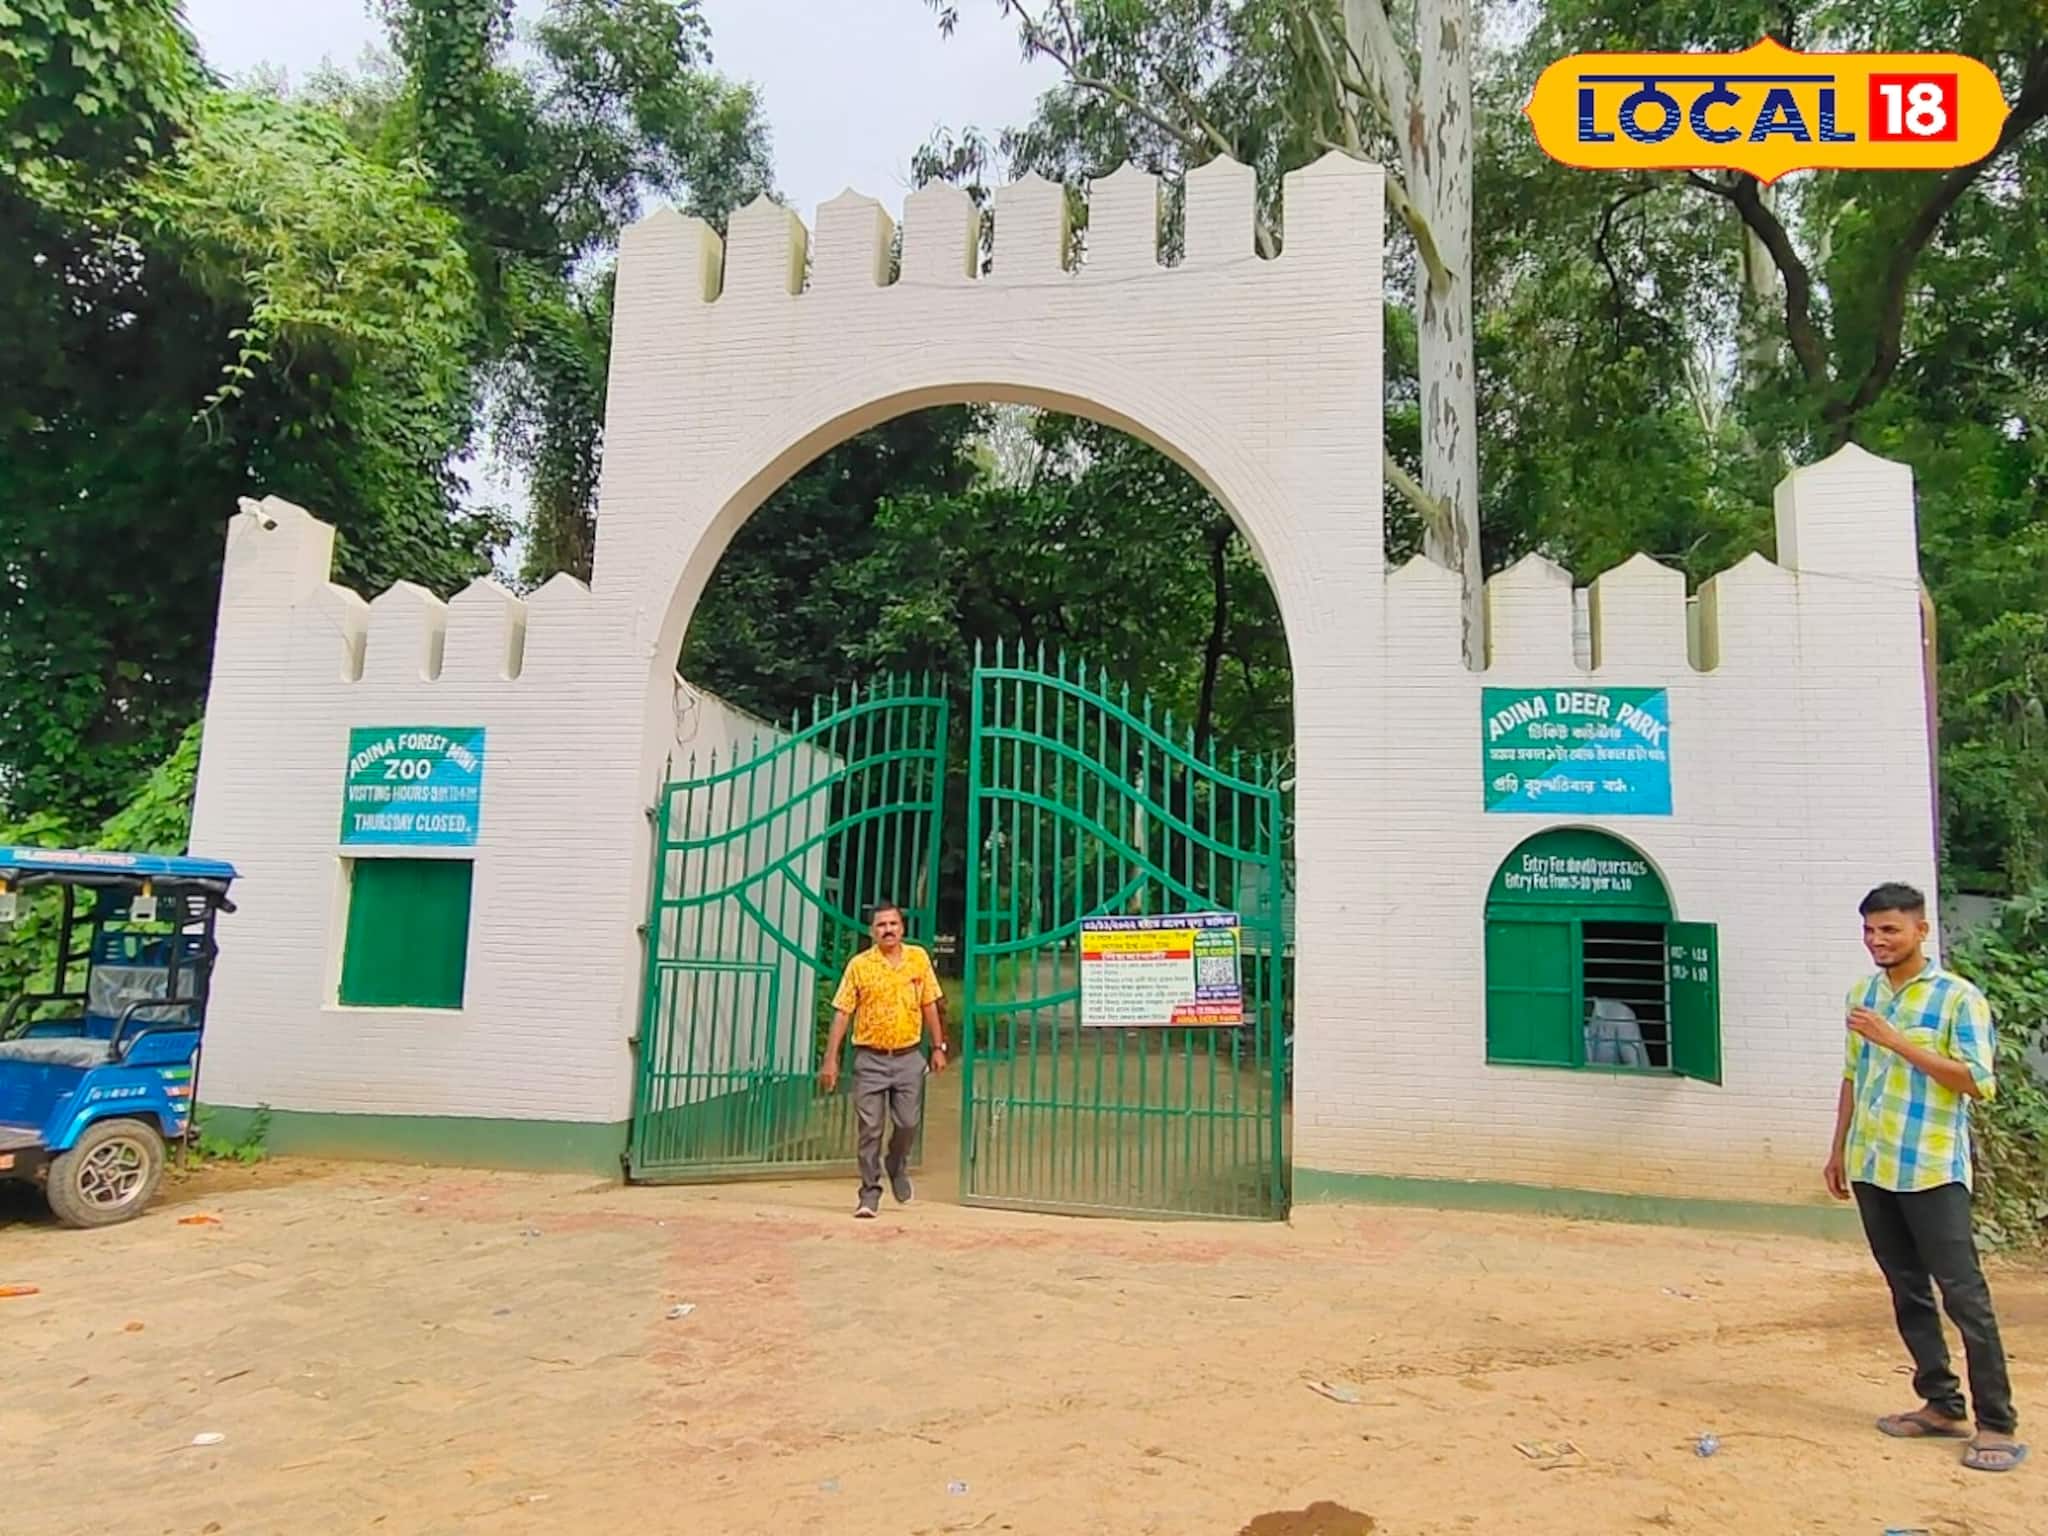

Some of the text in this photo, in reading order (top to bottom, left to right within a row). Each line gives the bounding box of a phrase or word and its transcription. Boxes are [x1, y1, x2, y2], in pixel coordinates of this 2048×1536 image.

[1488, 692, 1667, 746] ADINA DEER PARK
[350, 738, 395, 779] ADINA
[398, 733, 448, 752] FOREST
[384, 758, 431, 780] ZOO
[349, 784, 391, 802] VISITING
[354, 813, 412, 832] THURSDAY
[1522, 854, 1549, 875] Entry
[1549, 855, 1565, 873] Fee
[1505, 872, 1532, 893] Entry
[1533, 873, 1549, 889] Fee
